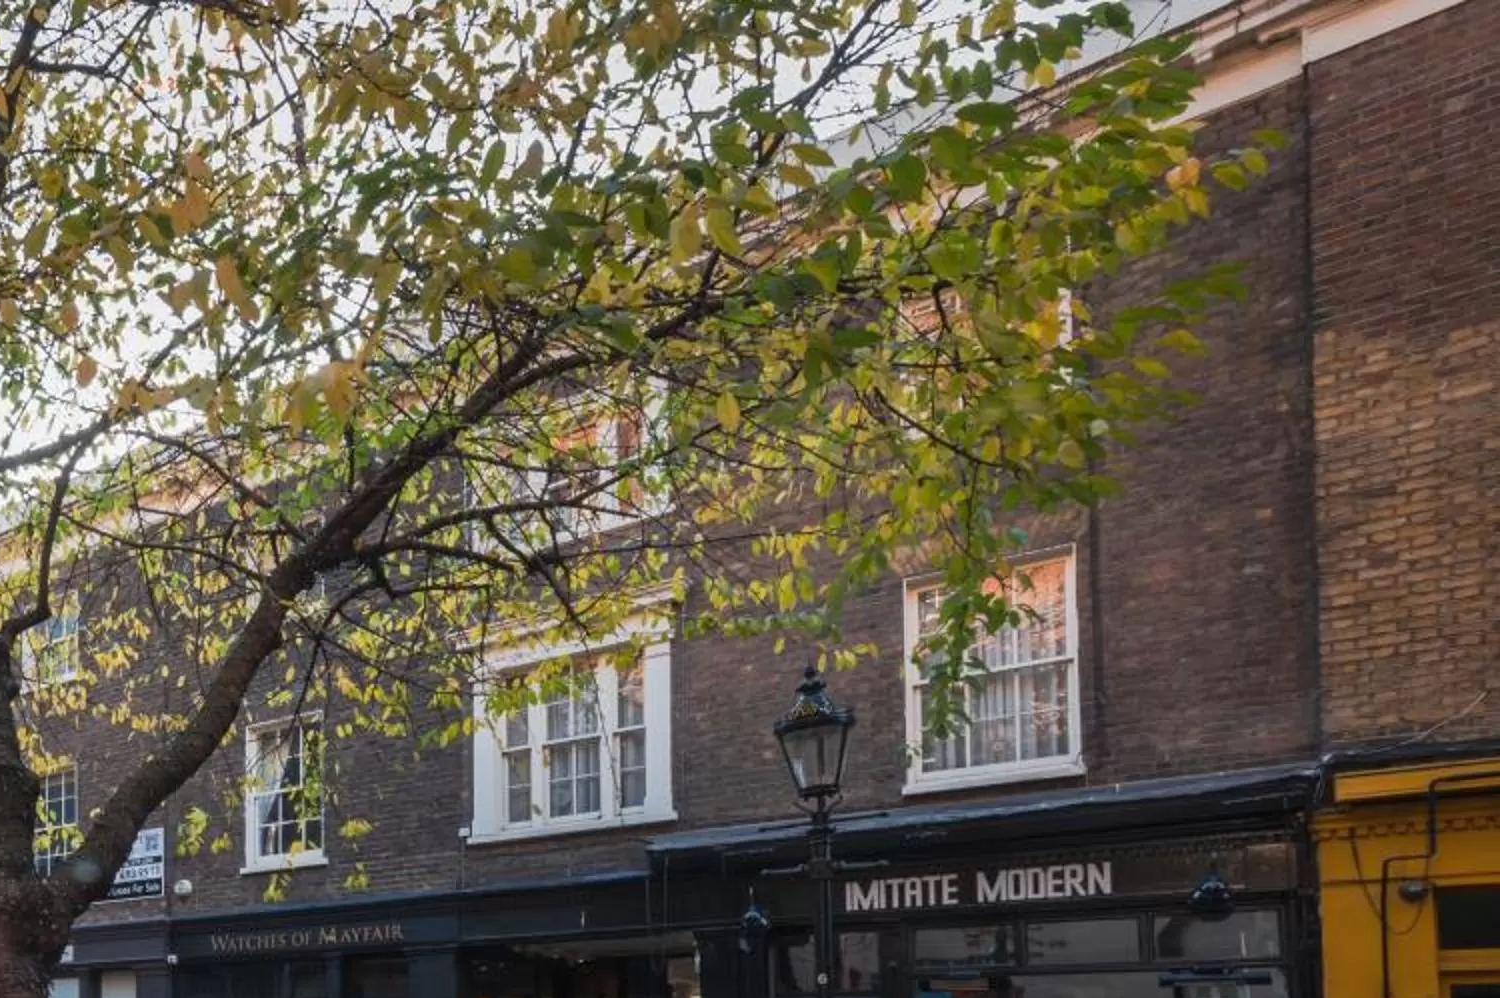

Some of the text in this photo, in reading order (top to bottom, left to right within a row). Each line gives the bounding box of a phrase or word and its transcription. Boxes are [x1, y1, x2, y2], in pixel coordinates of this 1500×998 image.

[845, 861, 1112, 912] IMITATE MODERN
[210, 923, 405, 953] WATCHES OF MAYFAIR
